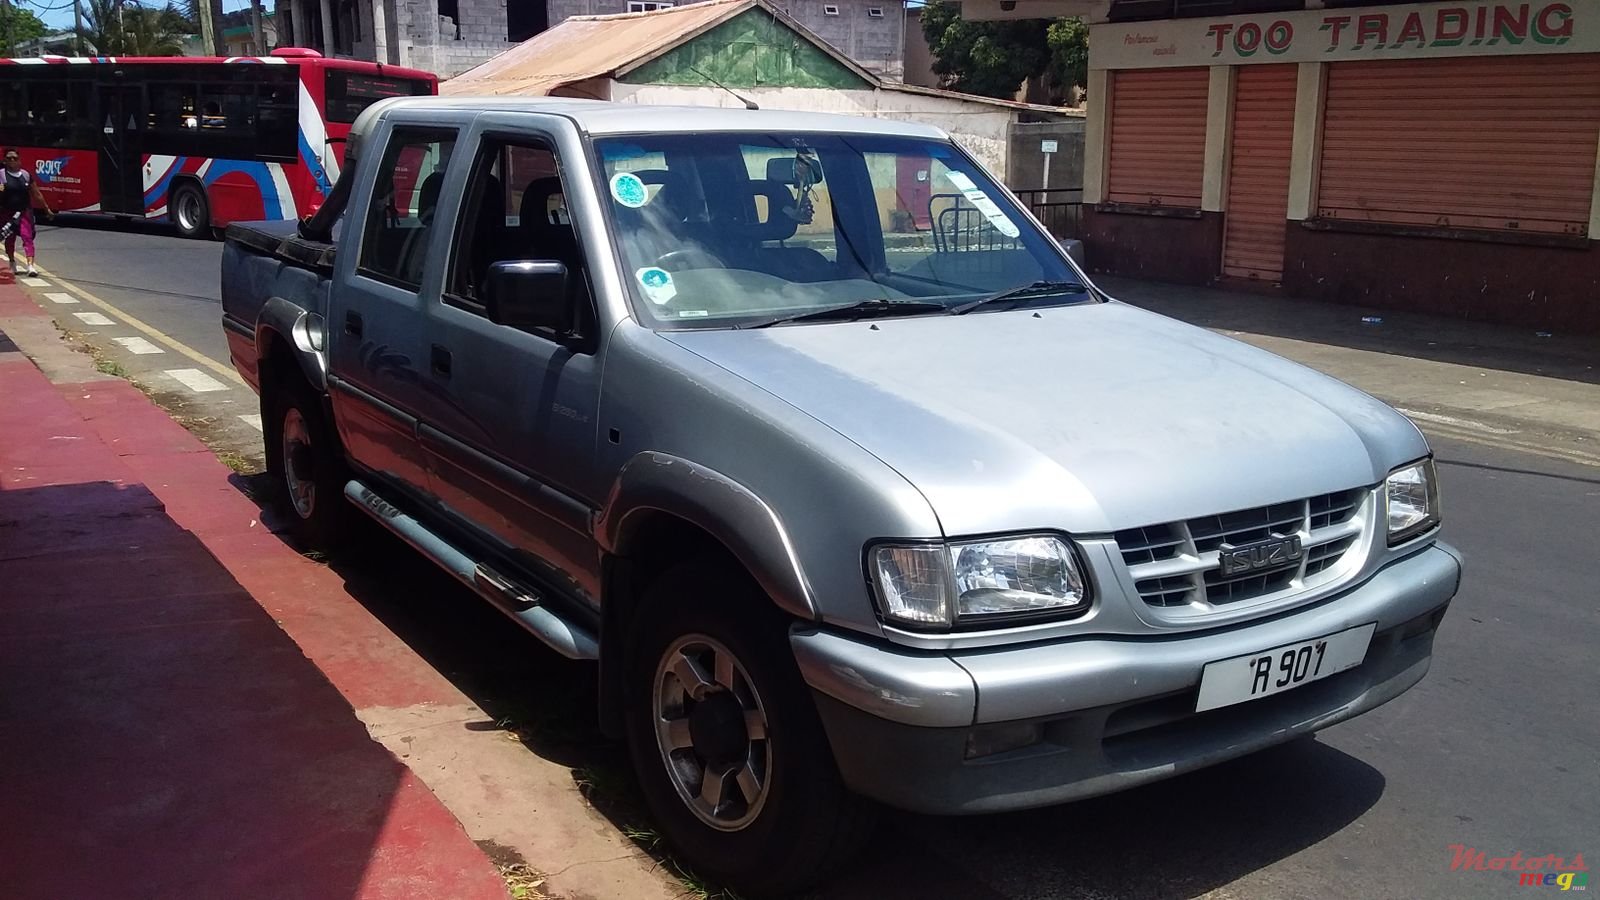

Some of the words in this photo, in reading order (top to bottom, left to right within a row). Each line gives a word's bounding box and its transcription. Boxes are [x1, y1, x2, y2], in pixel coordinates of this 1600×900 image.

[1206, 20, 1294, 57] TOO
[1319, 3, 1574, 52] TRADING
[1221, 538, 1301, 575] ISUZU
[1276, 642, 1327, 687] 901
